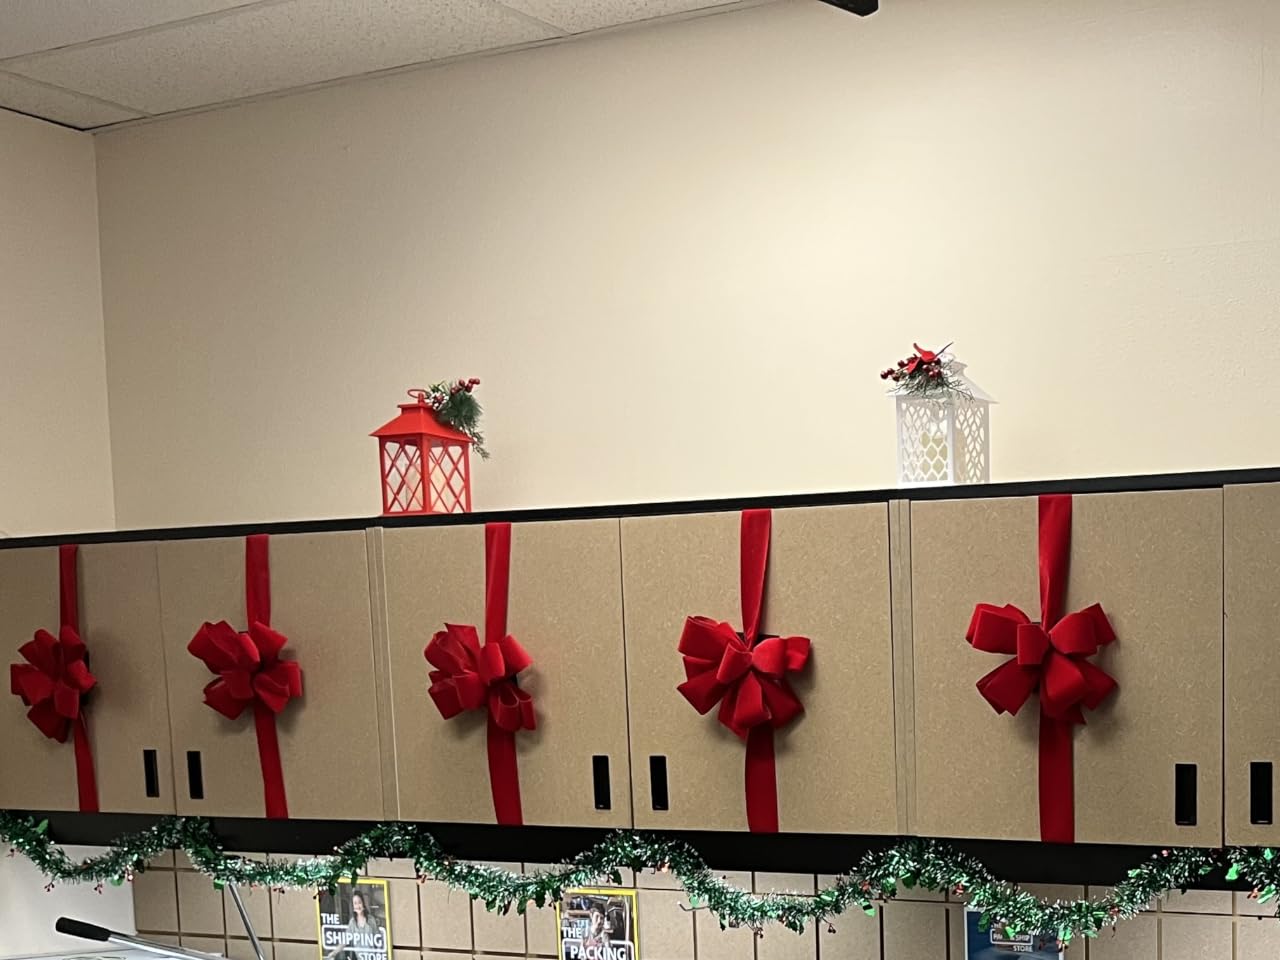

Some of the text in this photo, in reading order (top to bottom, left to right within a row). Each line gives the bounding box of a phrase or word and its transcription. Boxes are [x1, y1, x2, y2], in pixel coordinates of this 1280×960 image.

[321, 913, 340, 925] THE
[562, 927, 582, 938] THE
[326, 931, 382, 947] SHIPPING
